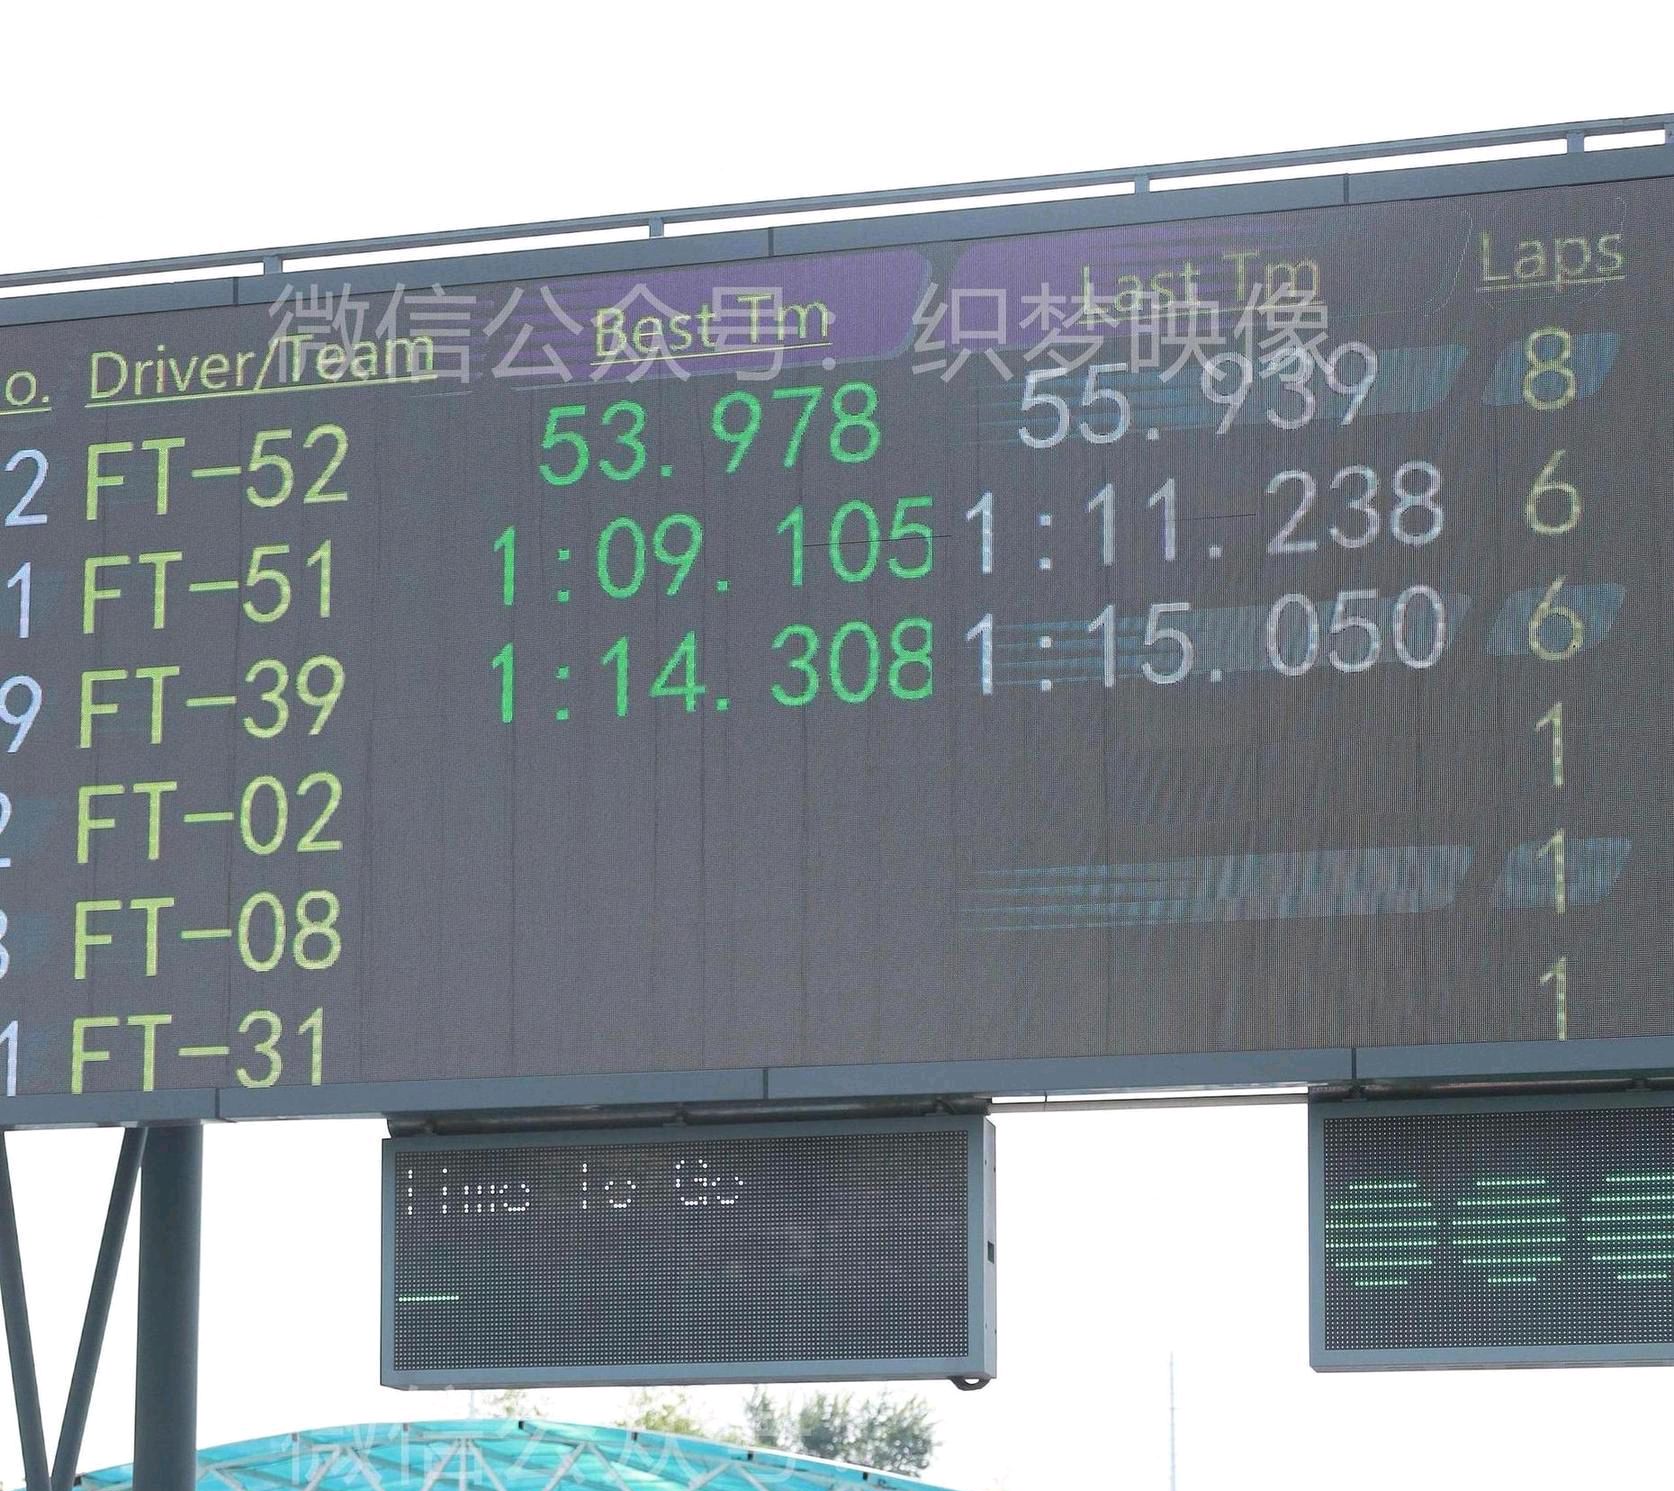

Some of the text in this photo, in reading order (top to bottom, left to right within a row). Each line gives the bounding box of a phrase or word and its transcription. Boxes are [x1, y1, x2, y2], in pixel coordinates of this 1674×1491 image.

[1080, 250, 1321, 317] Last Tm
[1480, 231, 1623, 291] Laps
[90, 333, 436, 400] Driver/Team
[594, 293, 829, 358] Best Tm
[1523, 326, 1576, 411] 8
[86, 424, 348, 521] FT-52
[1526, 450, 1581, 535] 6
[82, 539, 332, 635] FT-51
[1529, 575, 1584, 661] 6
[77, 655, 346, 749] FT-39
[1535, 701, 1564, 788] 1
[76, 772, 343, 864] FT-02
[1535, 828, 1565, 914] 1
[74, 890, 341, 980] FT-08
[1539, 956, 1568, 1041] 1
[71, 1007, 324, 1095] FT-31
